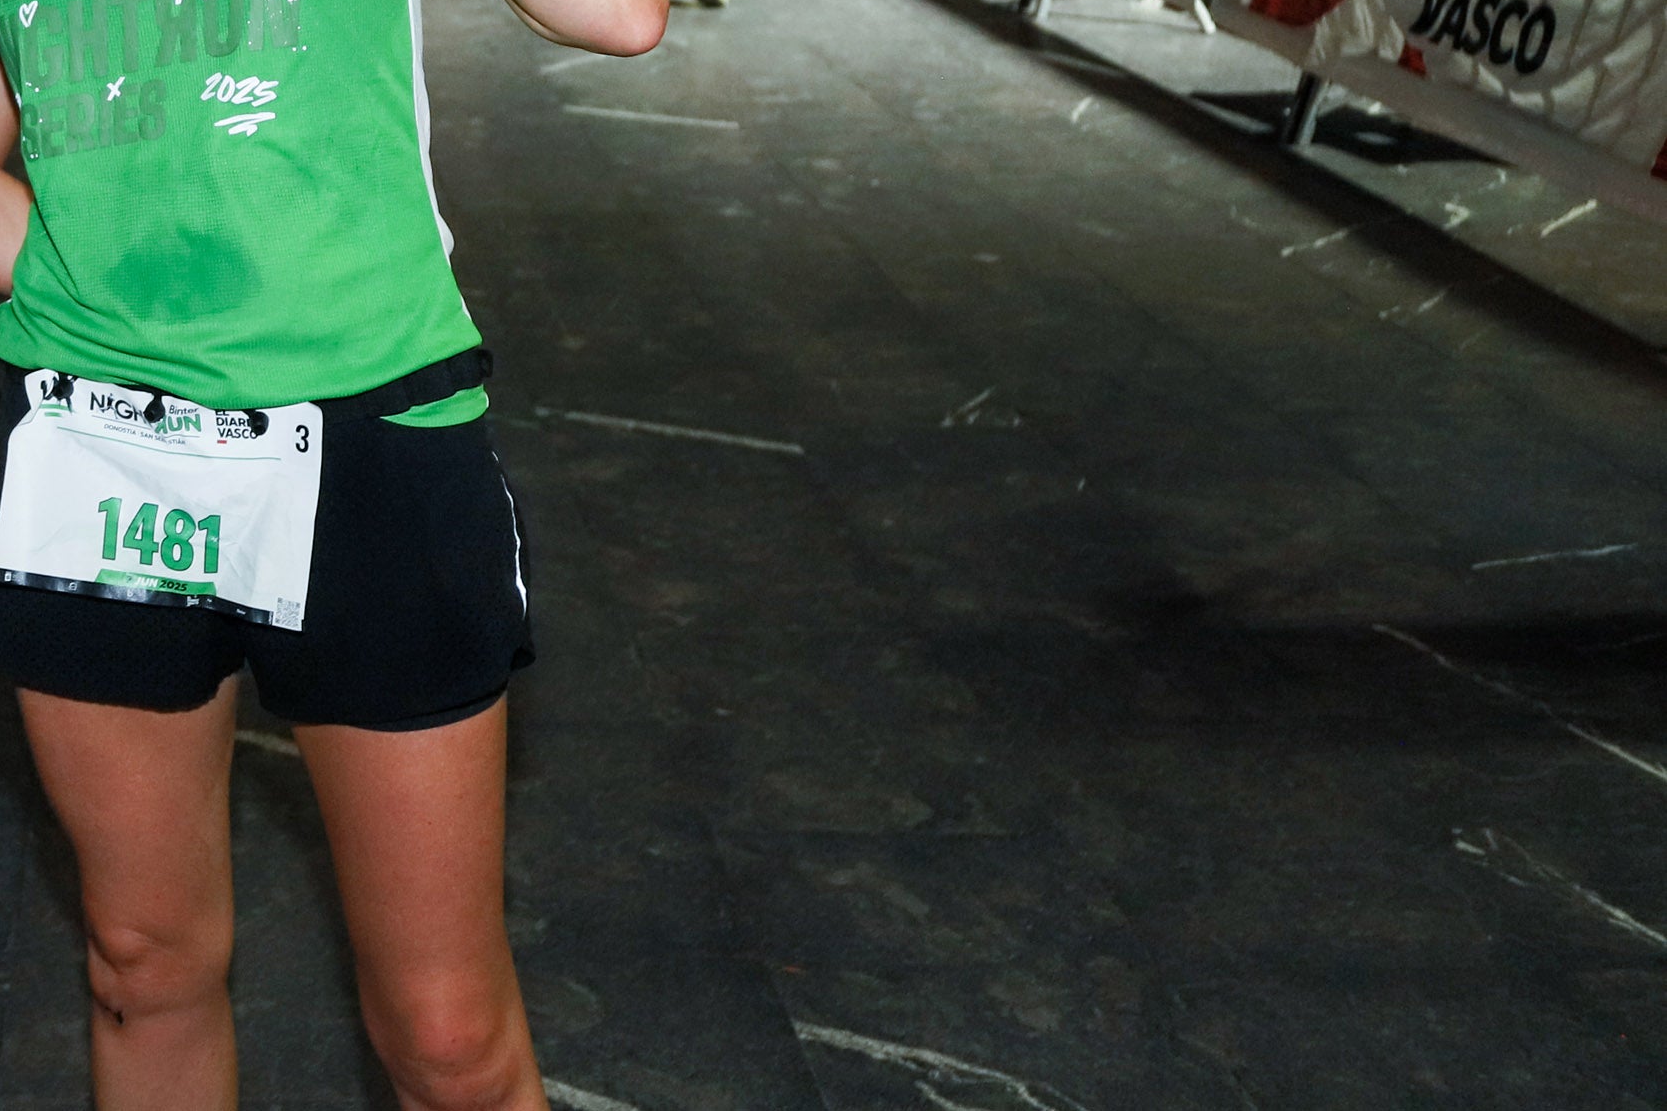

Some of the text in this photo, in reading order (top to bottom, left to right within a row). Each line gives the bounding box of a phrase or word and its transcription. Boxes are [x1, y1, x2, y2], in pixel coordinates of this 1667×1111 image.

[200, 71, 279, 108] 2025
[168, 404, 200, 416] Binter
[294, 424, 310, 454] 3
[97, 496, 222, 574] 1481
[134, 576, 159, 588] JUN
[159, 579, 188, 592] 2025
